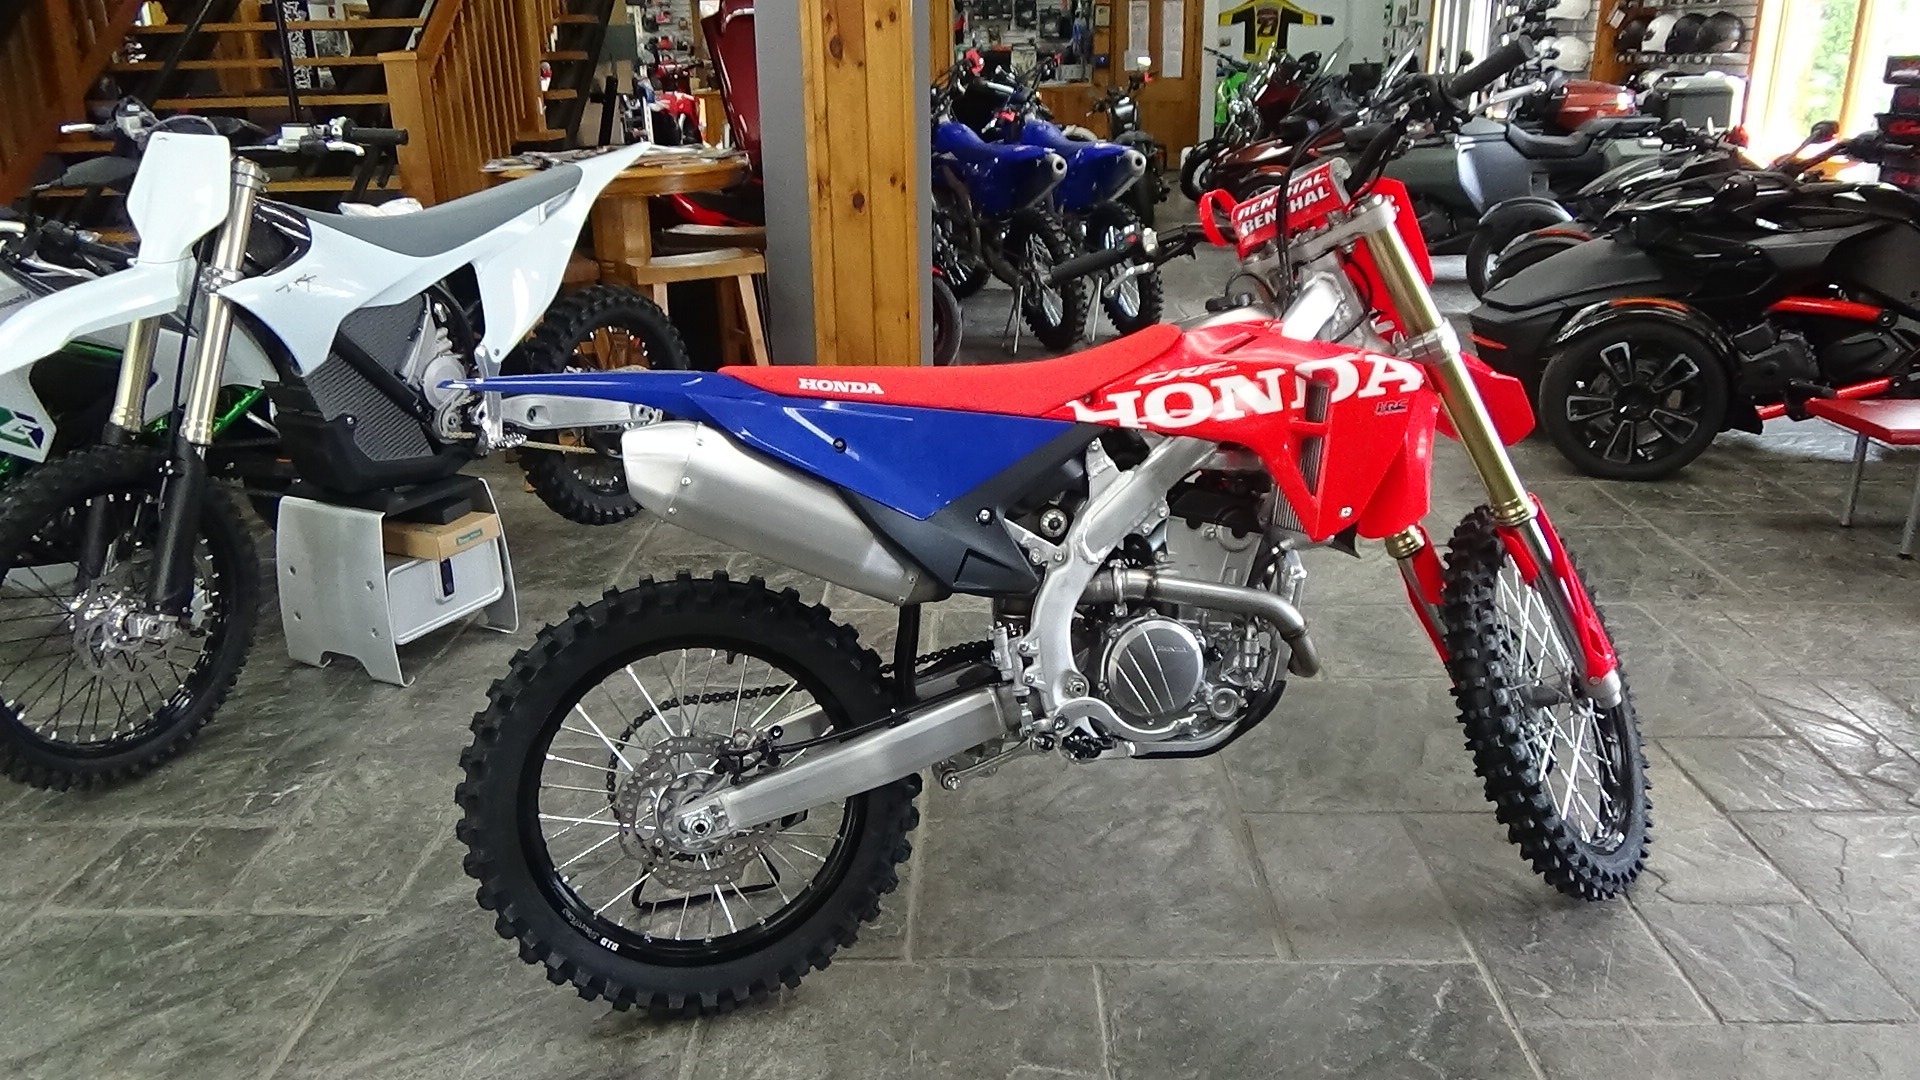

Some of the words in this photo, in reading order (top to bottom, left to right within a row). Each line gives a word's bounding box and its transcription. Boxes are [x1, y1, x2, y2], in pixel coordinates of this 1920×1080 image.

[1237, 172, 1328, 220] RENHAL
[1240, 186, 1331, 237] RENHAL
[798, 378, 885, 395] HONDA
[1066, 354, 1424, 429] HONDA
